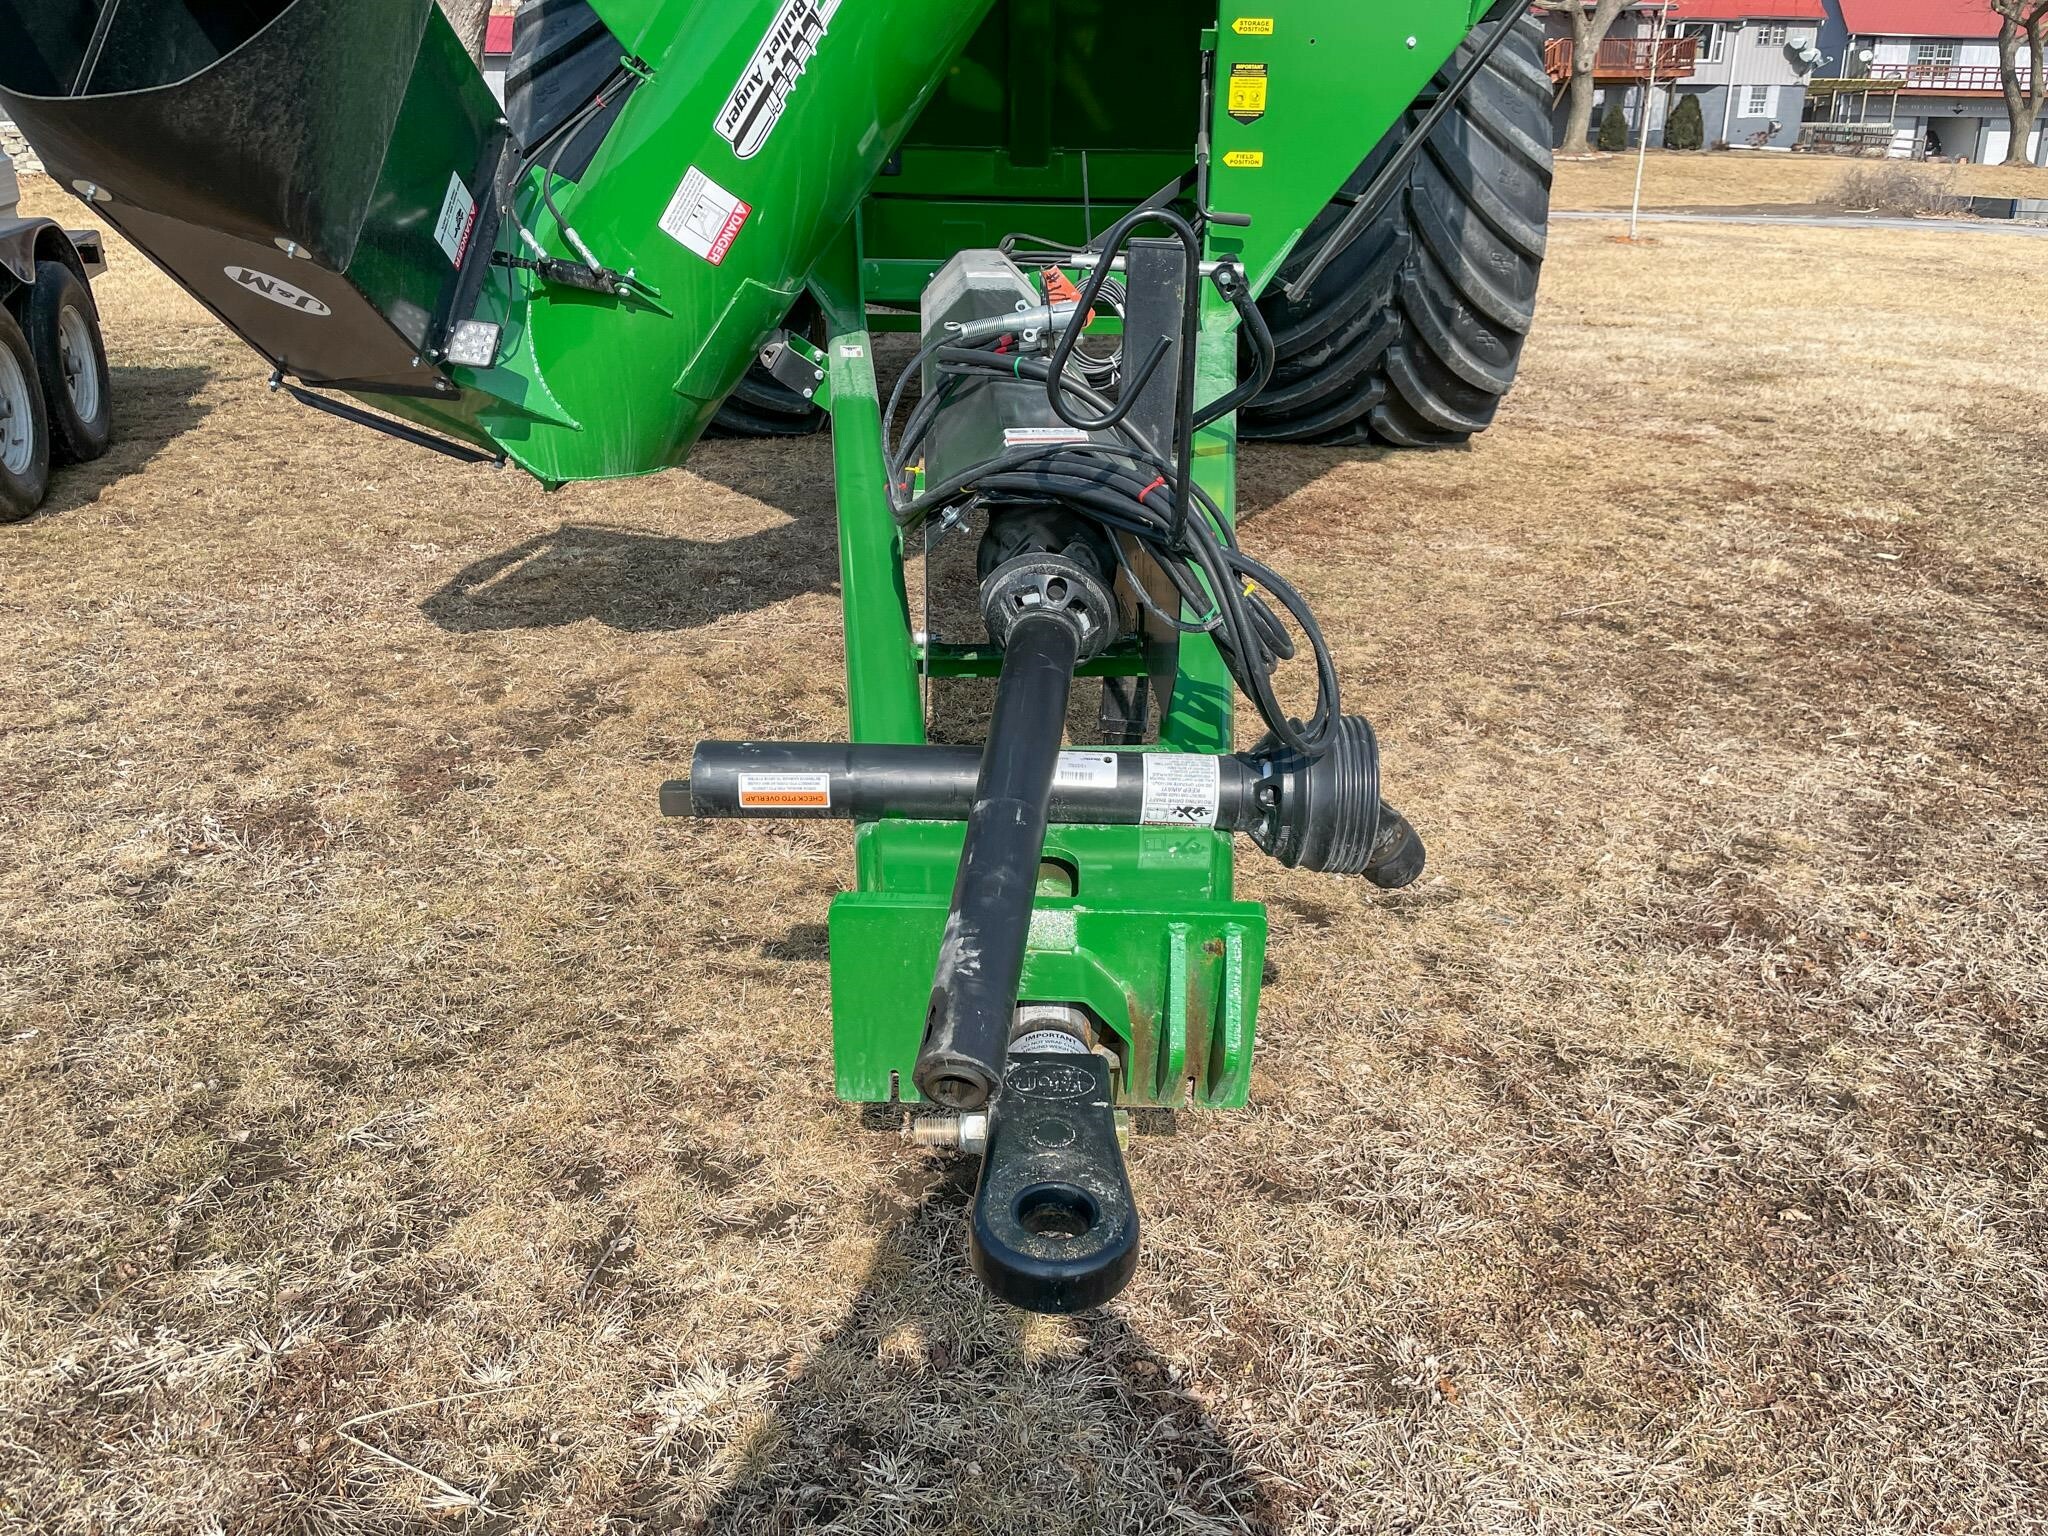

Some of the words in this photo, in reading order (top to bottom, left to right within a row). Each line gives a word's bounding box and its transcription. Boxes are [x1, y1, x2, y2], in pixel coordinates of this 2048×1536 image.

[763, 0, 807, 65] Bullet
[726, 65, 765, 133] Auger
[455, 217, 474, 268] DANGER
[709, 214, 743, 263] DANGER
[237, 268, 325, 311] J&M
[1025, 1032, 1077, 1044] IMPORTANT
